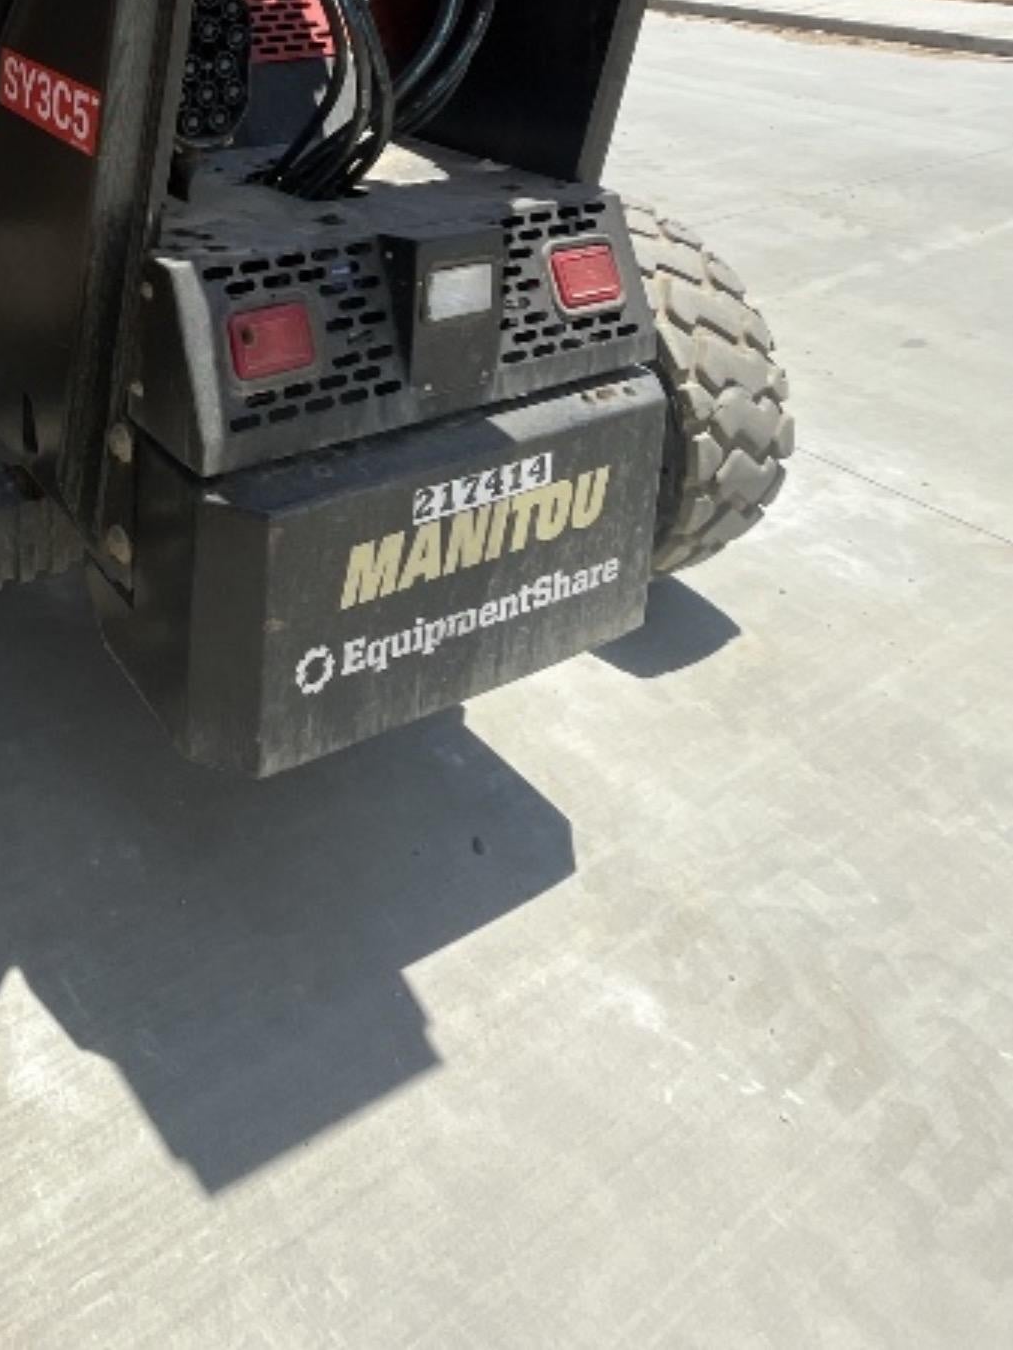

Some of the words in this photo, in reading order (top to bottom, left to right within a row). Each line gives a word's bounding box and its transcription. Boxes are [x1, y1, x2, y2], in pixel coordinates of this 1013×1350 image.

[4, 56, 100, 140] SY3C5
[415, 452, 550, 523] 217414
[340, 465, 611, 611] MANITOU
[340, 557, 620, 674] EquipmentShare
